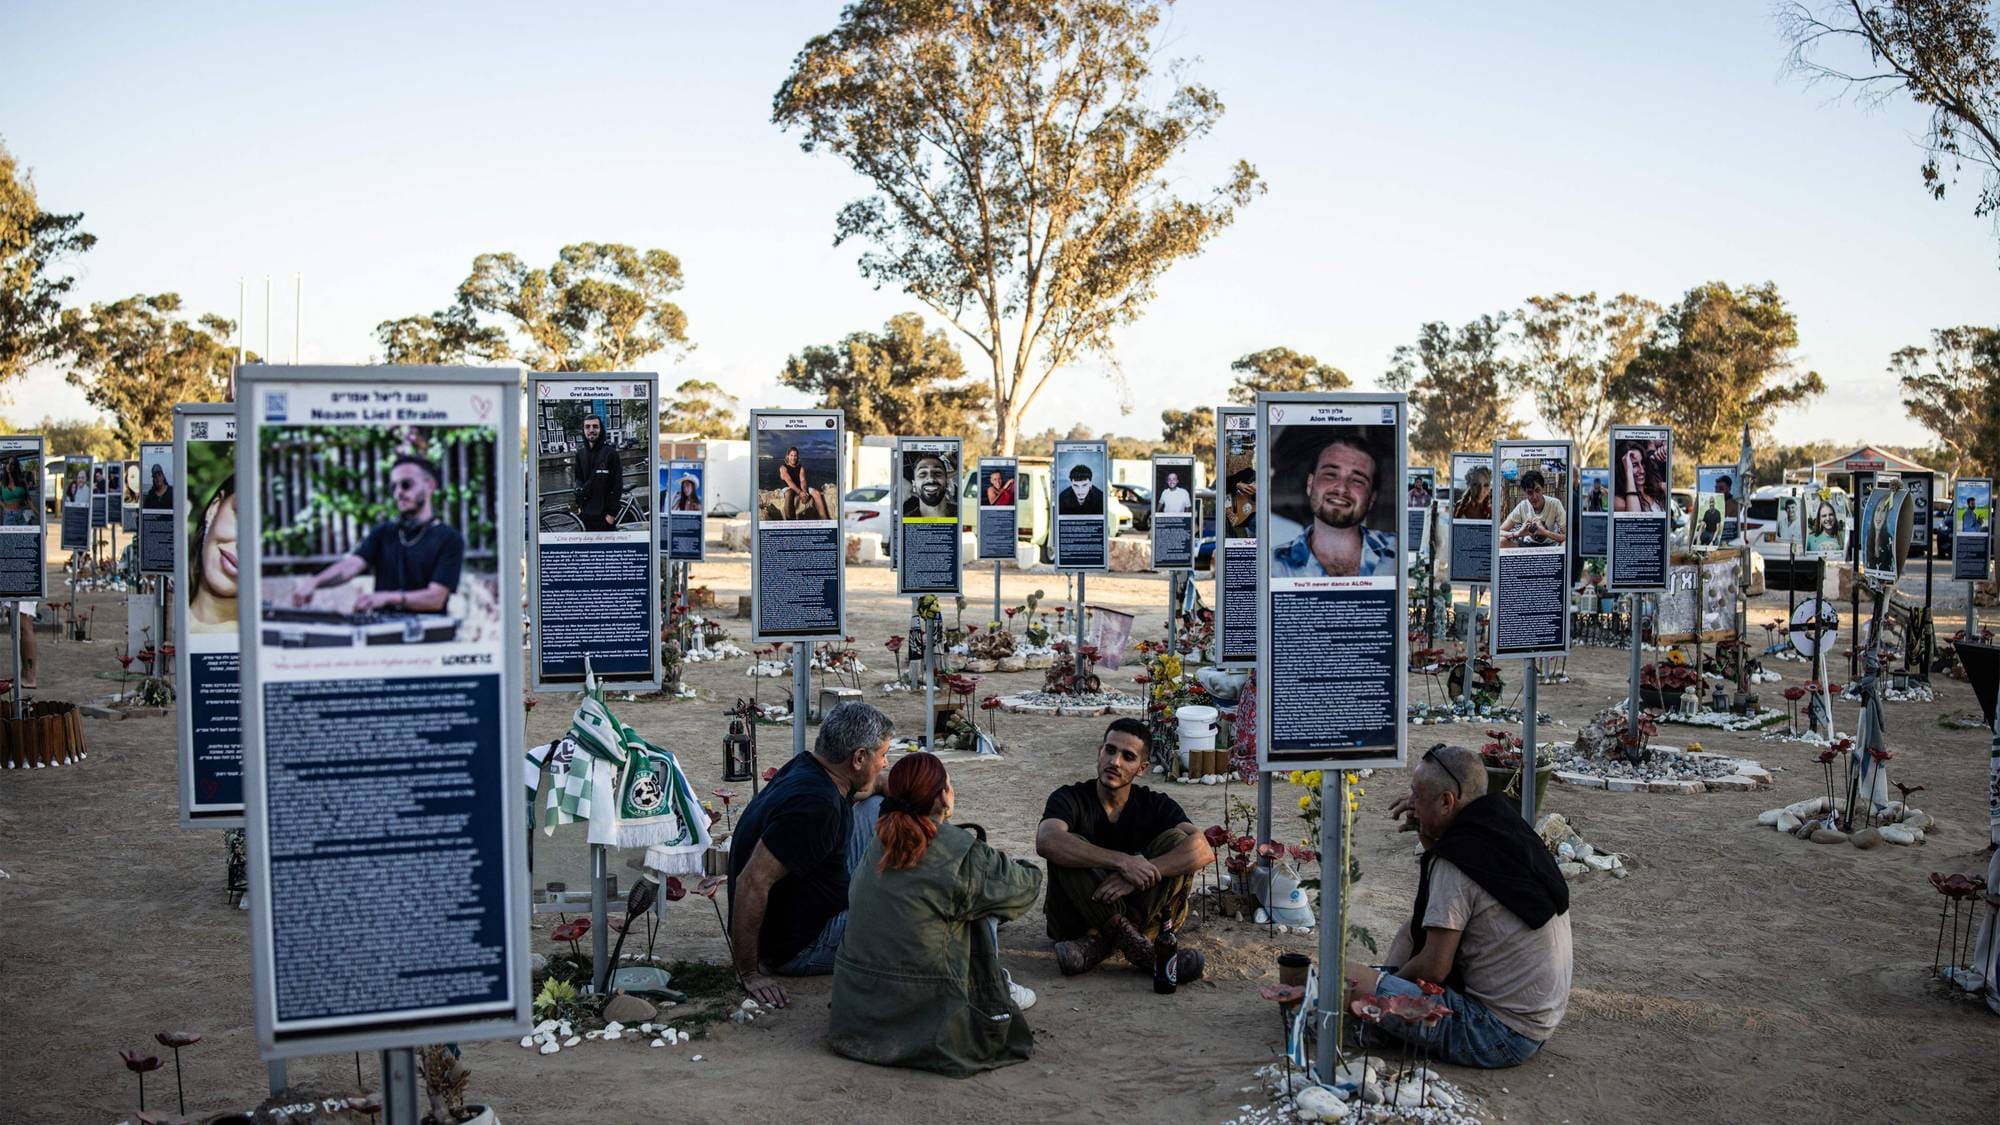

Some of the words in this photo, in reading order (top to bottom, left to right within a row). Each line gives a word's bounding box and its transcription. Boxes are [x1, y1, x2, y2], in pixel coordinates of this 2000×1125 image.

[311, 408, 357, 420] Noam
[363, 408, 391, 420] Liel
[396, 408, 448, 420] Efraim
